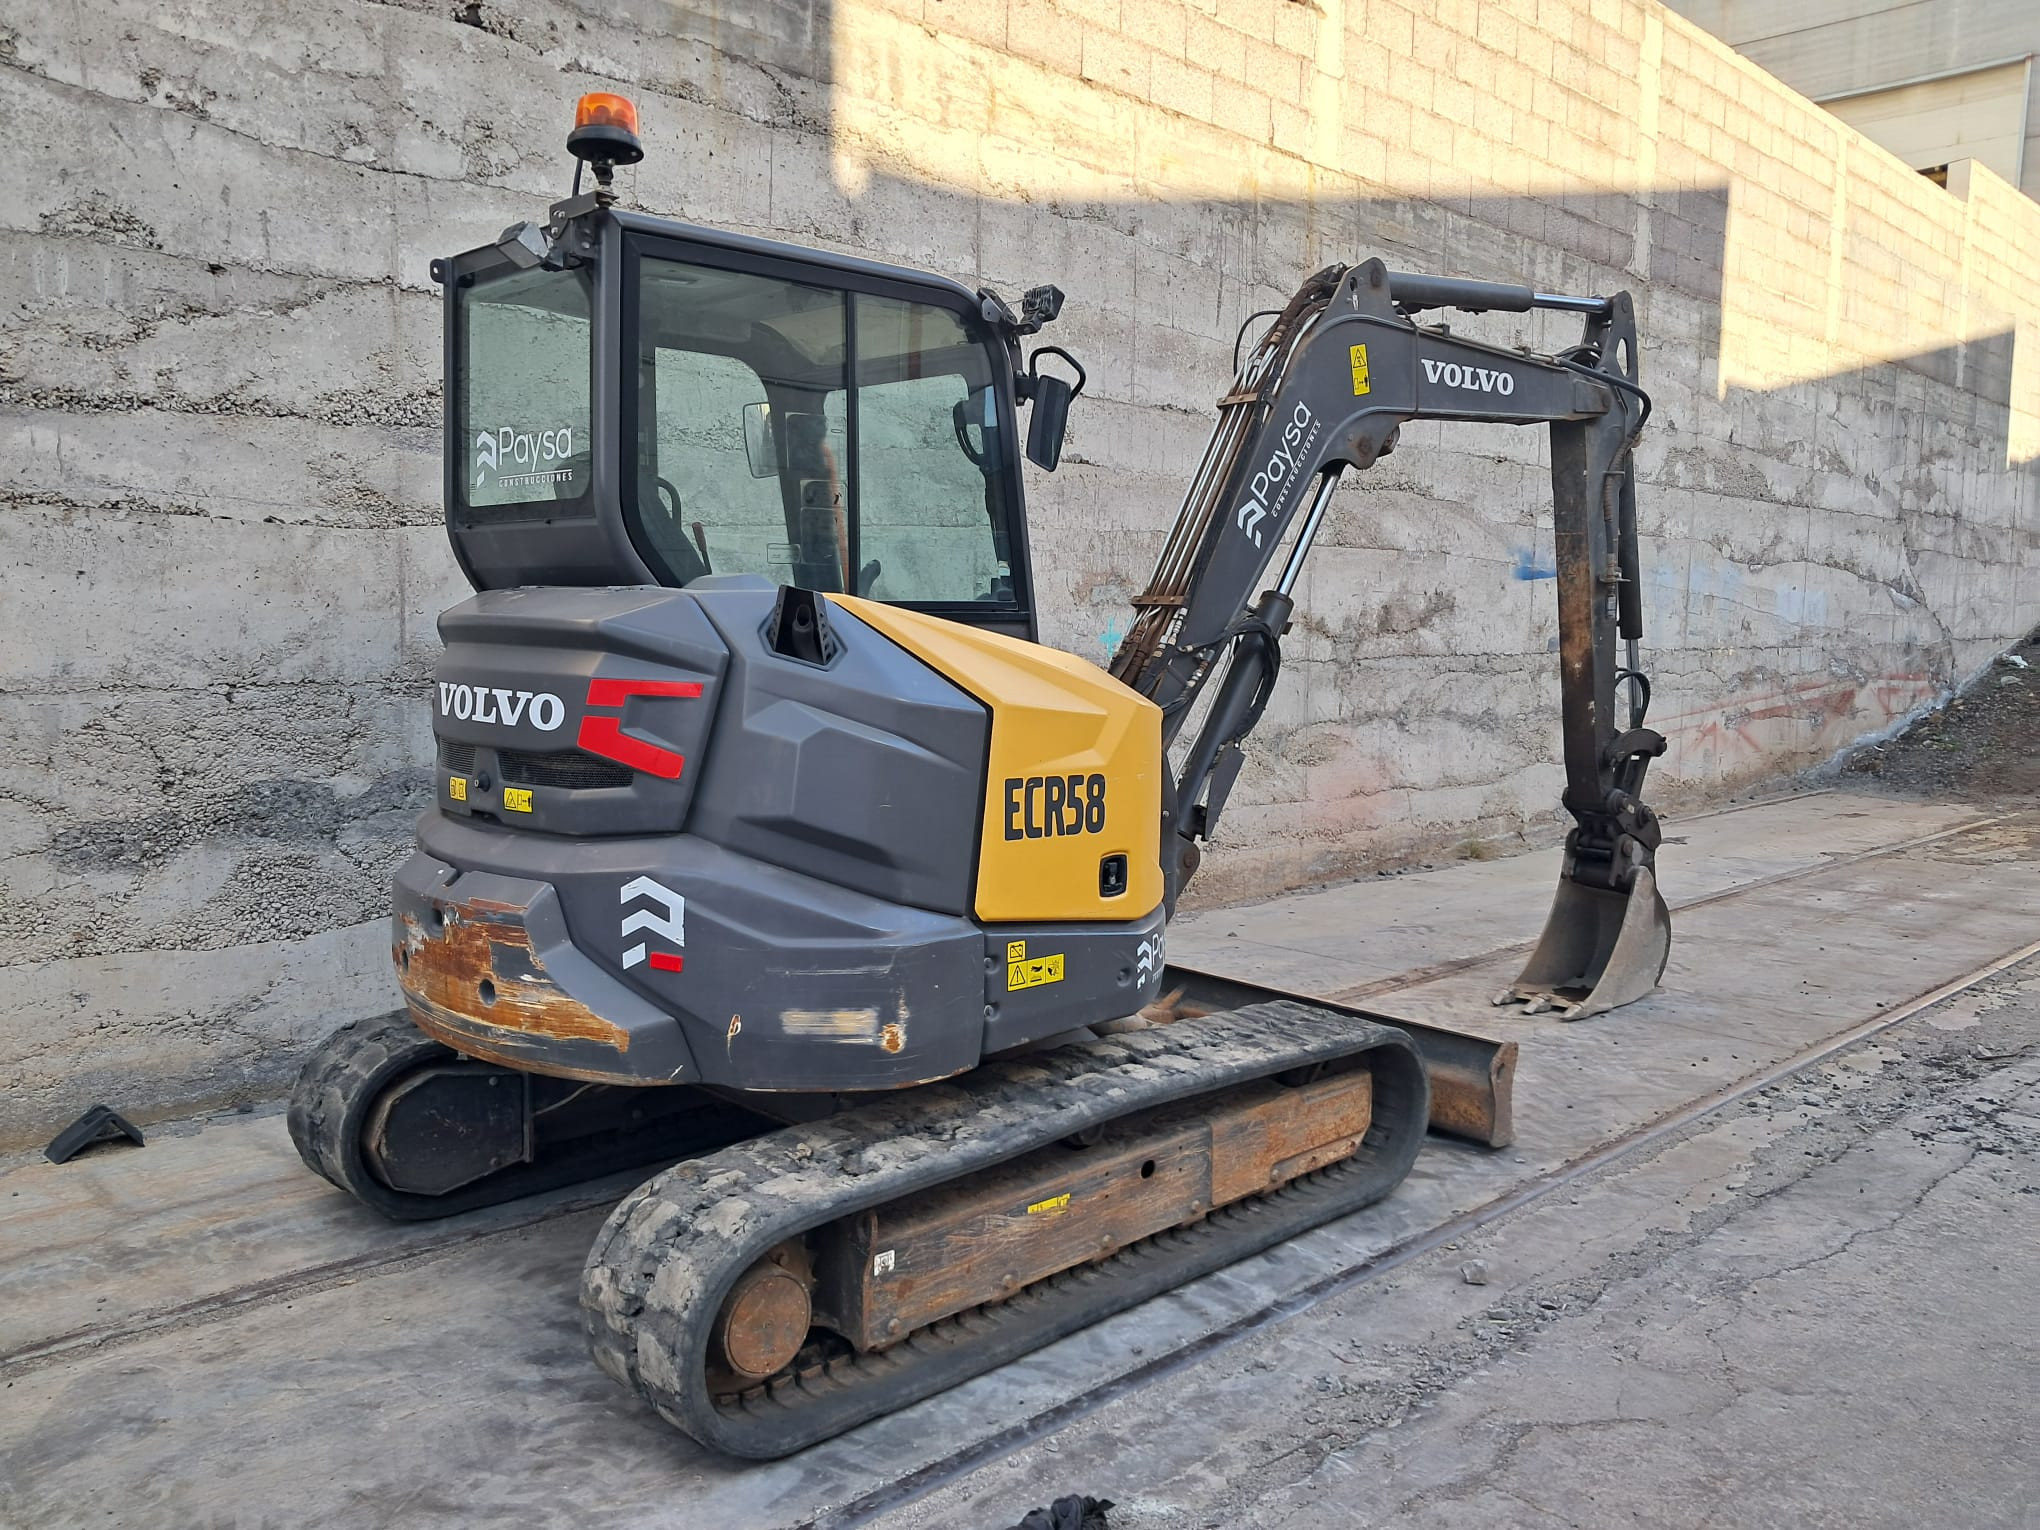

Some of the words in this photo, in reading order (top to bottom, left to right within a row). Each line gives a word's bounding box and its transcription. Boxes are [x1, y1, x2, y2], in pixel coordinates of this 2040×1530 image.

[1420, 358, 1515, 396] VOLVO
[498, 426, 572, 473] Paysa
[1250, 400, 1312, 506] Paysa
[1272, 420, 1322, 518] CONSTRUCCIONES
[498, 471, 573, 488] CONSTRUCCIONES
[438, 681, 566, 732] VOLVO
[1004, 773, 1106, 841] ECR58
